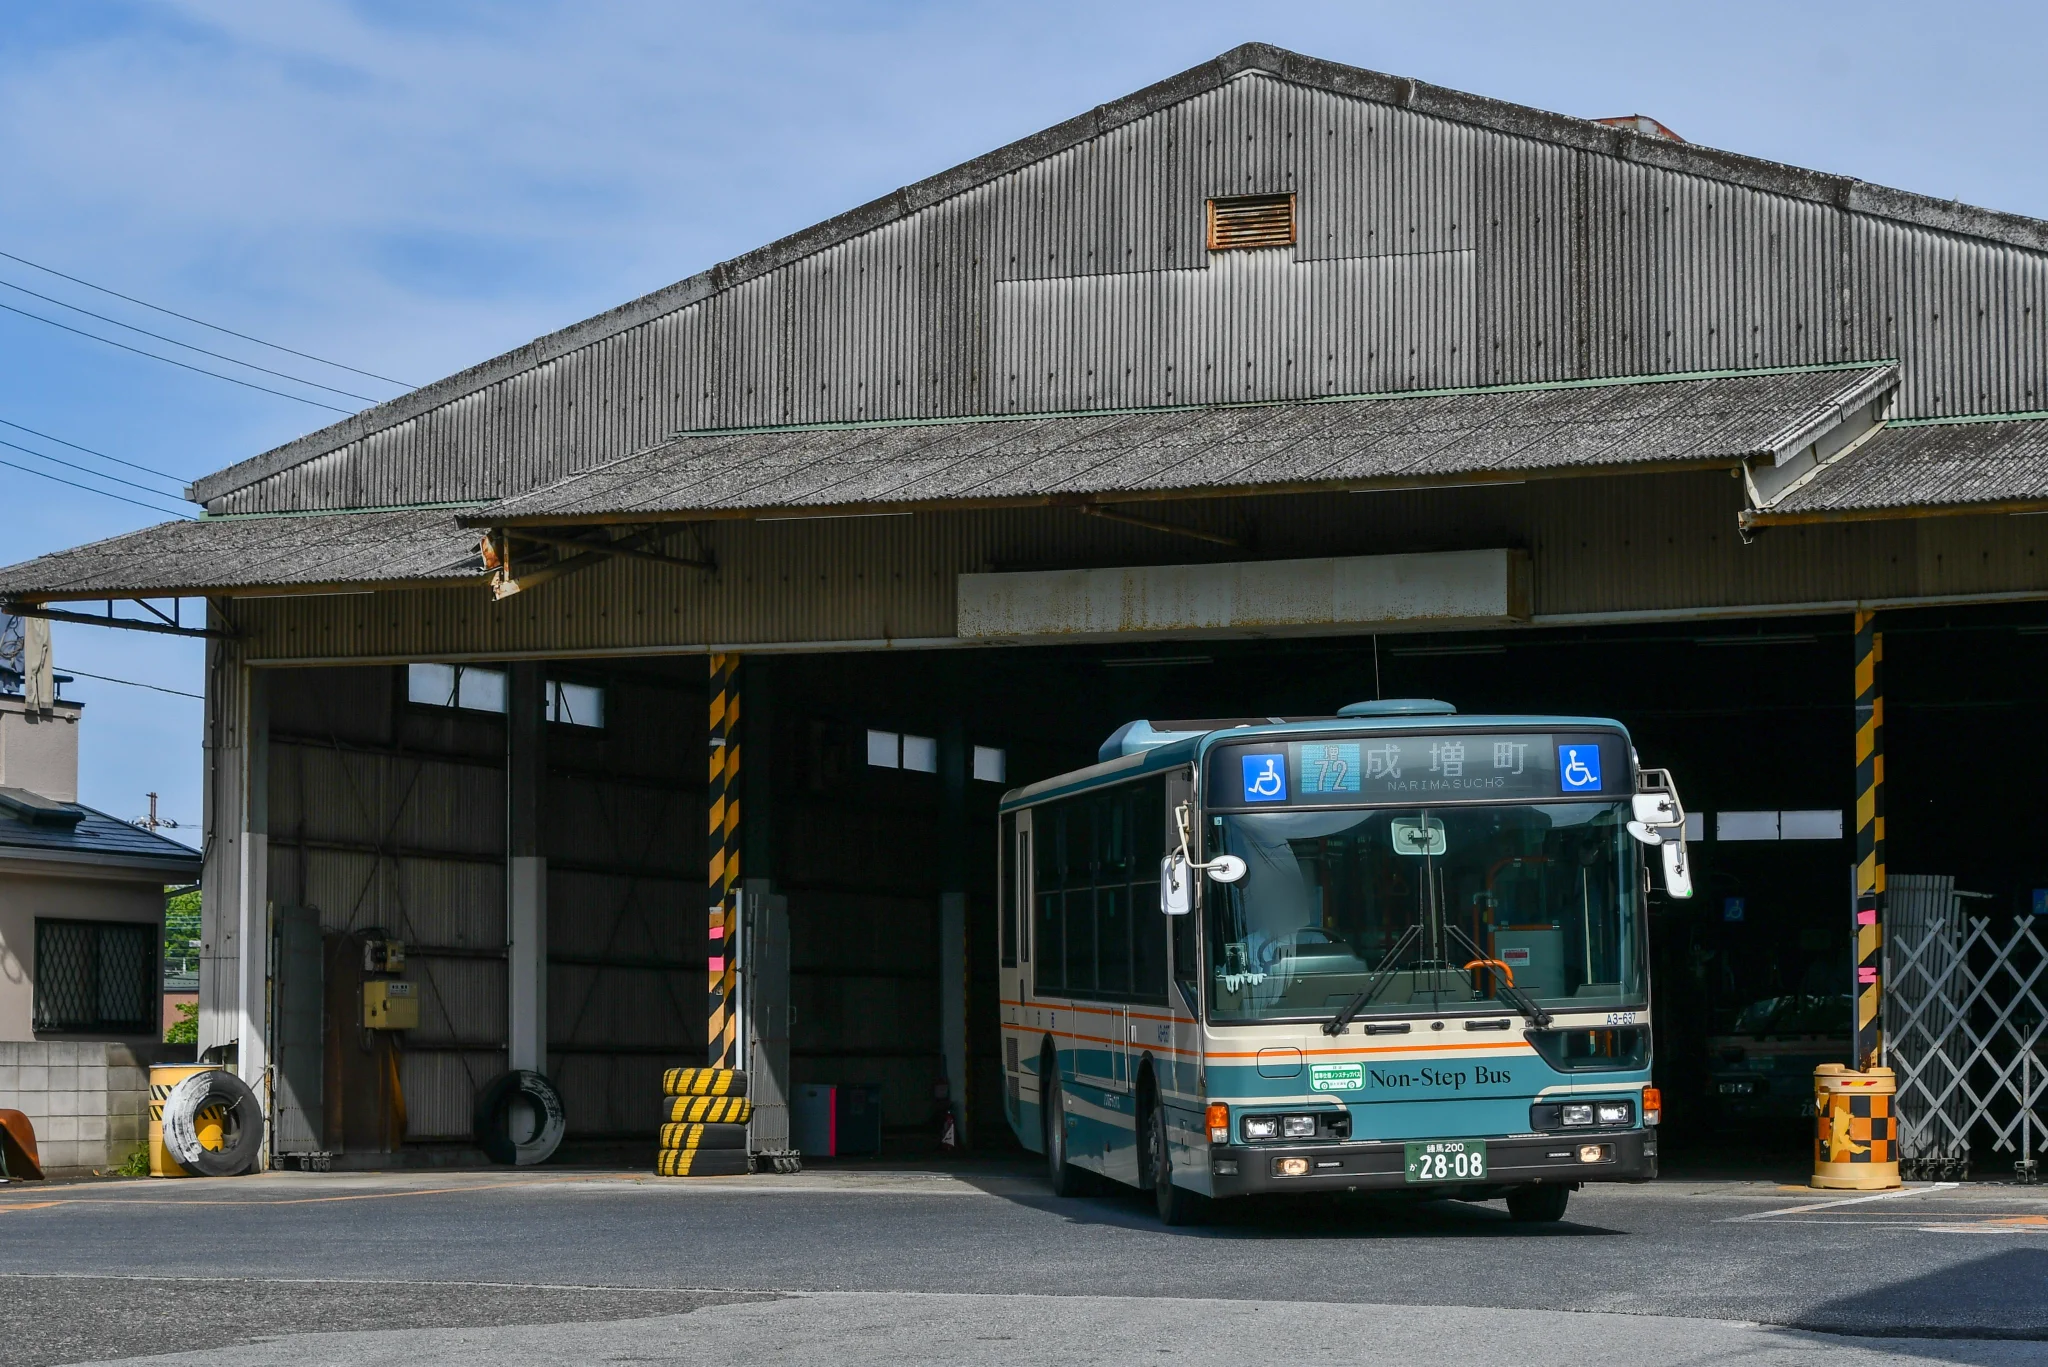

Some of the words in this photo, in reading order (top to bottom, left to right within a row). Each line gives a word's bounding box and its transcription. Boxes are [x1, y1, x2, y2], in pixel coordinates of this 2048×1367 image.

[1323, 745, 1340, 761] 増
[1364, 741, 1528, 779] 成増町
[1314, 760, 1348, 791] 72
[1606, 1012, 1636, 1026] A3-637
[1369, 1067, 1467, 1091] Non-Step
[1474, 1065, 1512, 1085] Bus
[1419, 1152, 1483, 1179] 28-08
